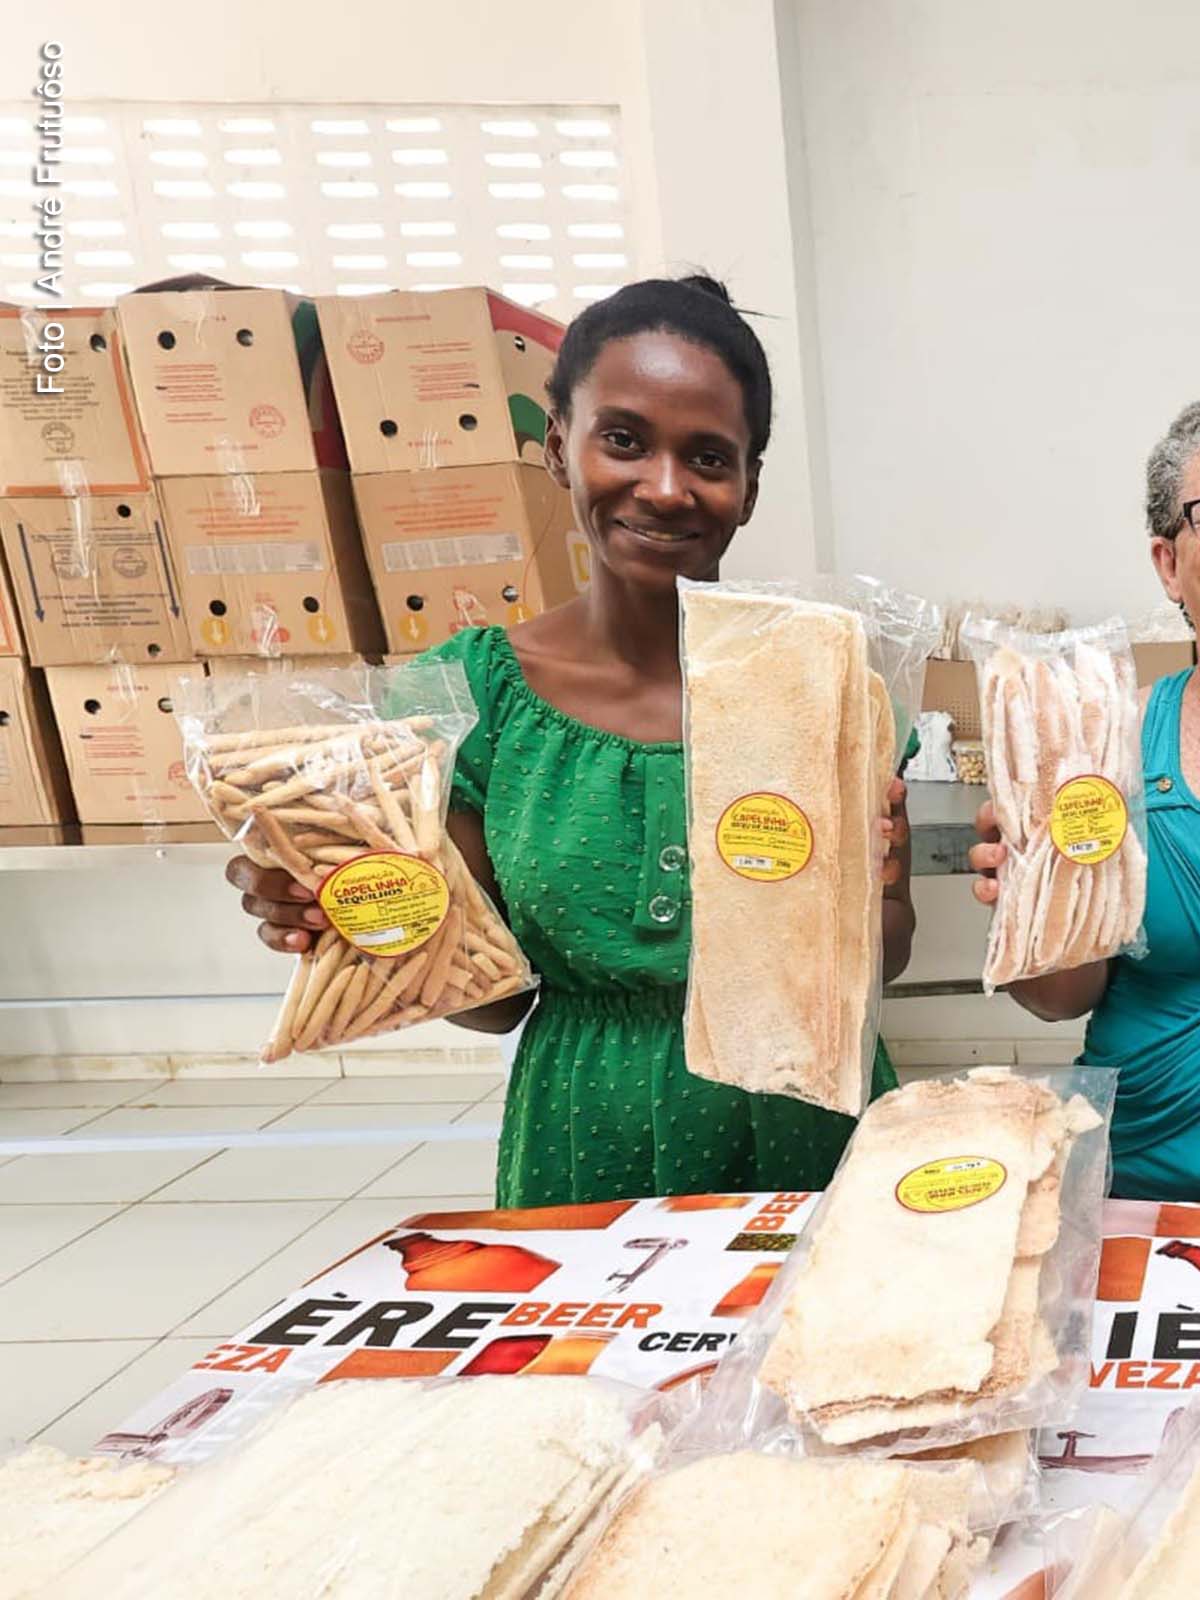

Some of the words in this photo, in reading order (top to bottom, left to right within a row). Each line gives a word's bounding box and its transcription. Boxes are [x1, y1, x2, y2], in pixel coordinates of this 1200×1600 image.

[333, 877, 408, 899] CAPELINHA
[336, 888, 404, 906] SEQUILHOS
[247, 1292, 515, 1349] ÈRE
[500, 1302, 663, 1330] BEER
[638, 1332, 737, 1352] CER
